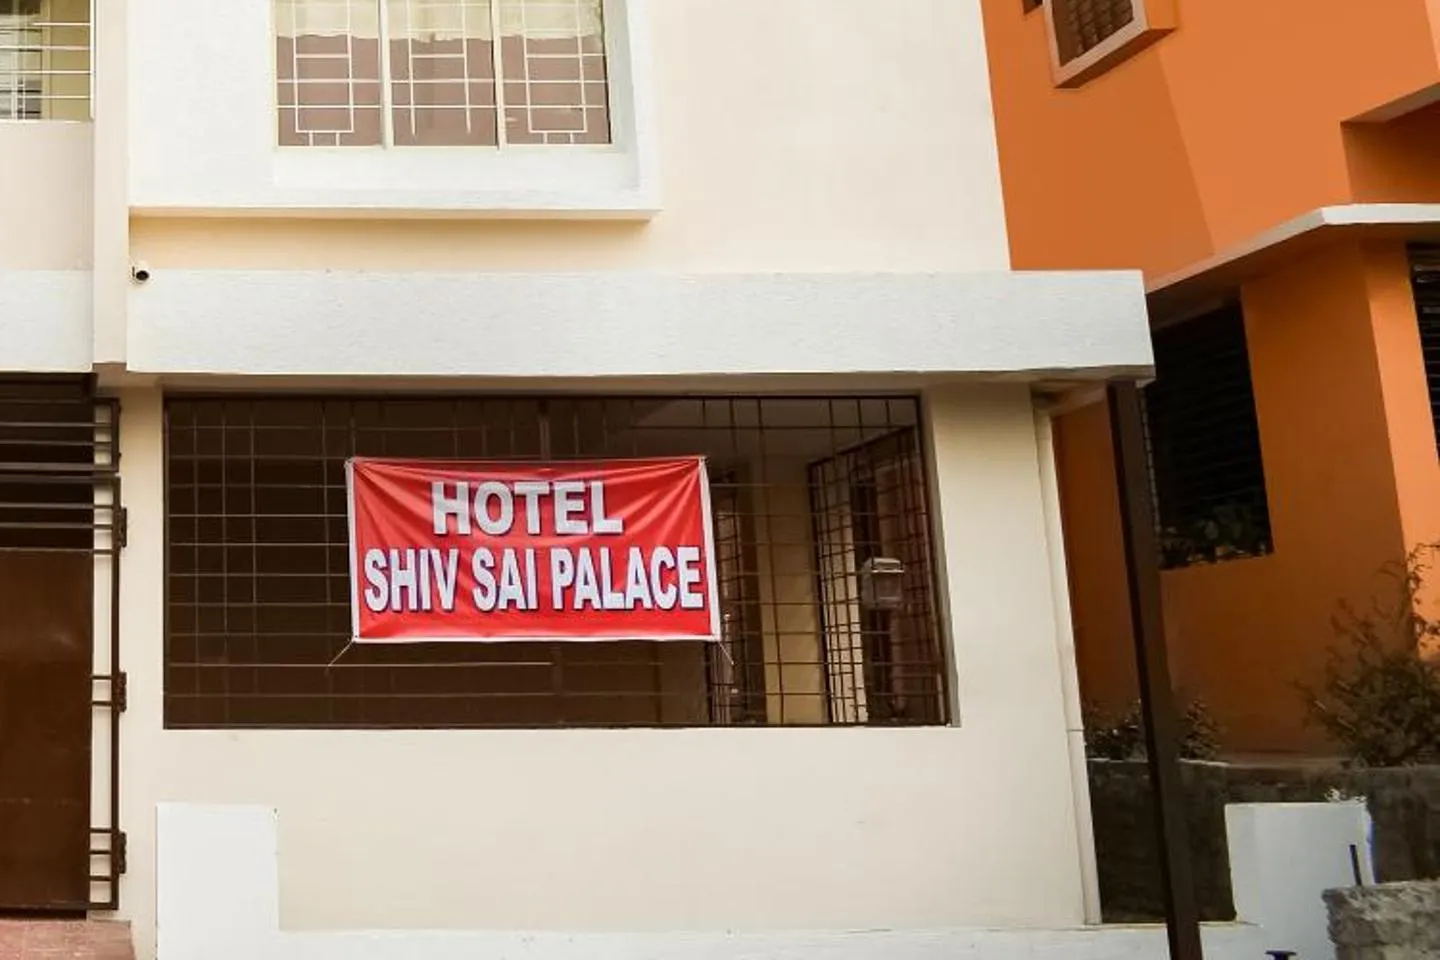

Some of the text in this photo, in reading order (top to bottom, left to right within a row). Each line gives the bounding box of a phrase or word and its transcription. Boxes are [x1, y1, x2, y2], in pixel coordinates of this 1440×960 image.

[430, 480, 625, 537] HOTEL
[363, 545, 704, 614] SHIV SAI PALACE
